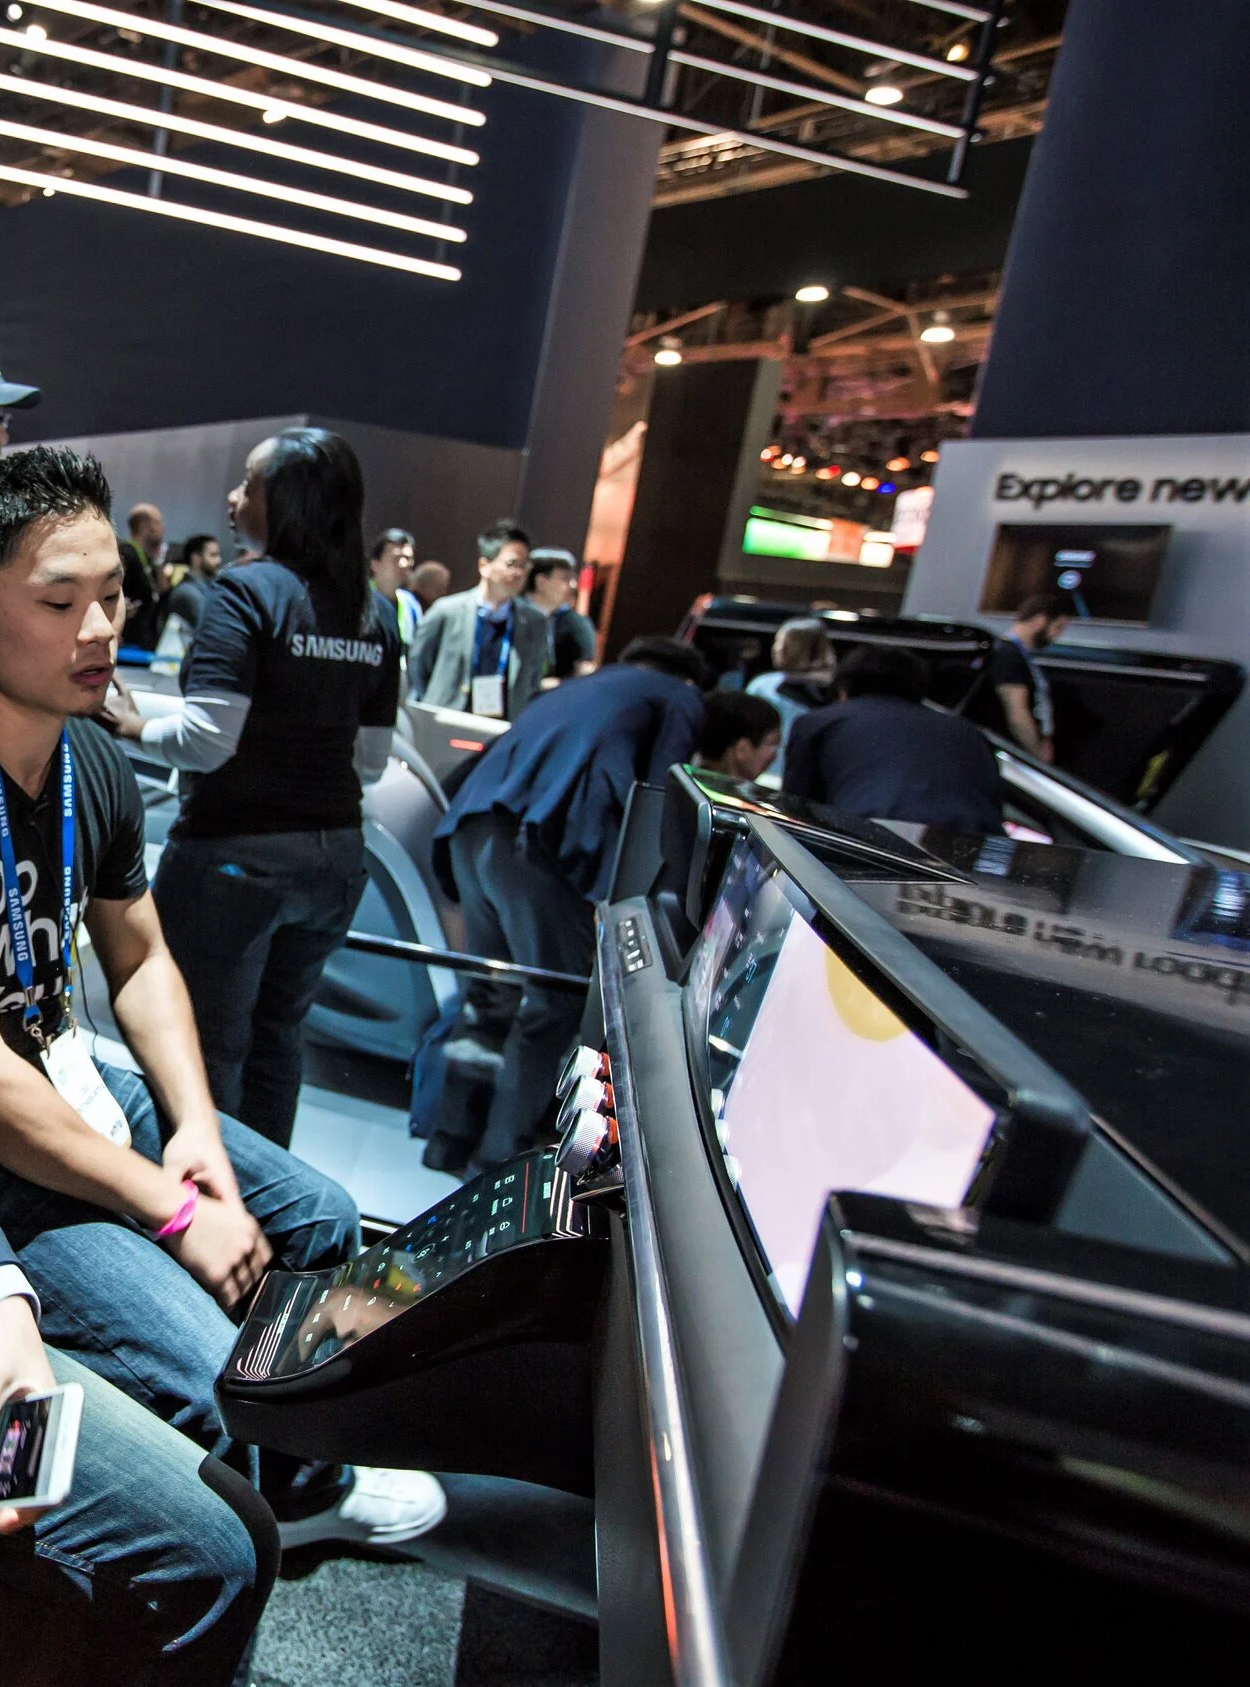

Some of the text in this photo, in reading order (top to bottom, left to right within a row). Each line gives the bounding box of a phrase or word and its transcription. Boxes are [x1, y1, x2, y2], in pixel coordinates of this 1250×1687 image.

[995, 472, 1250, 511] Explore new
[291, 633, 384, 667] SAMSUNG
[63, 743, 73, 817] SAMSUNG
[8, 887, 29, 962] SAMSUNG
